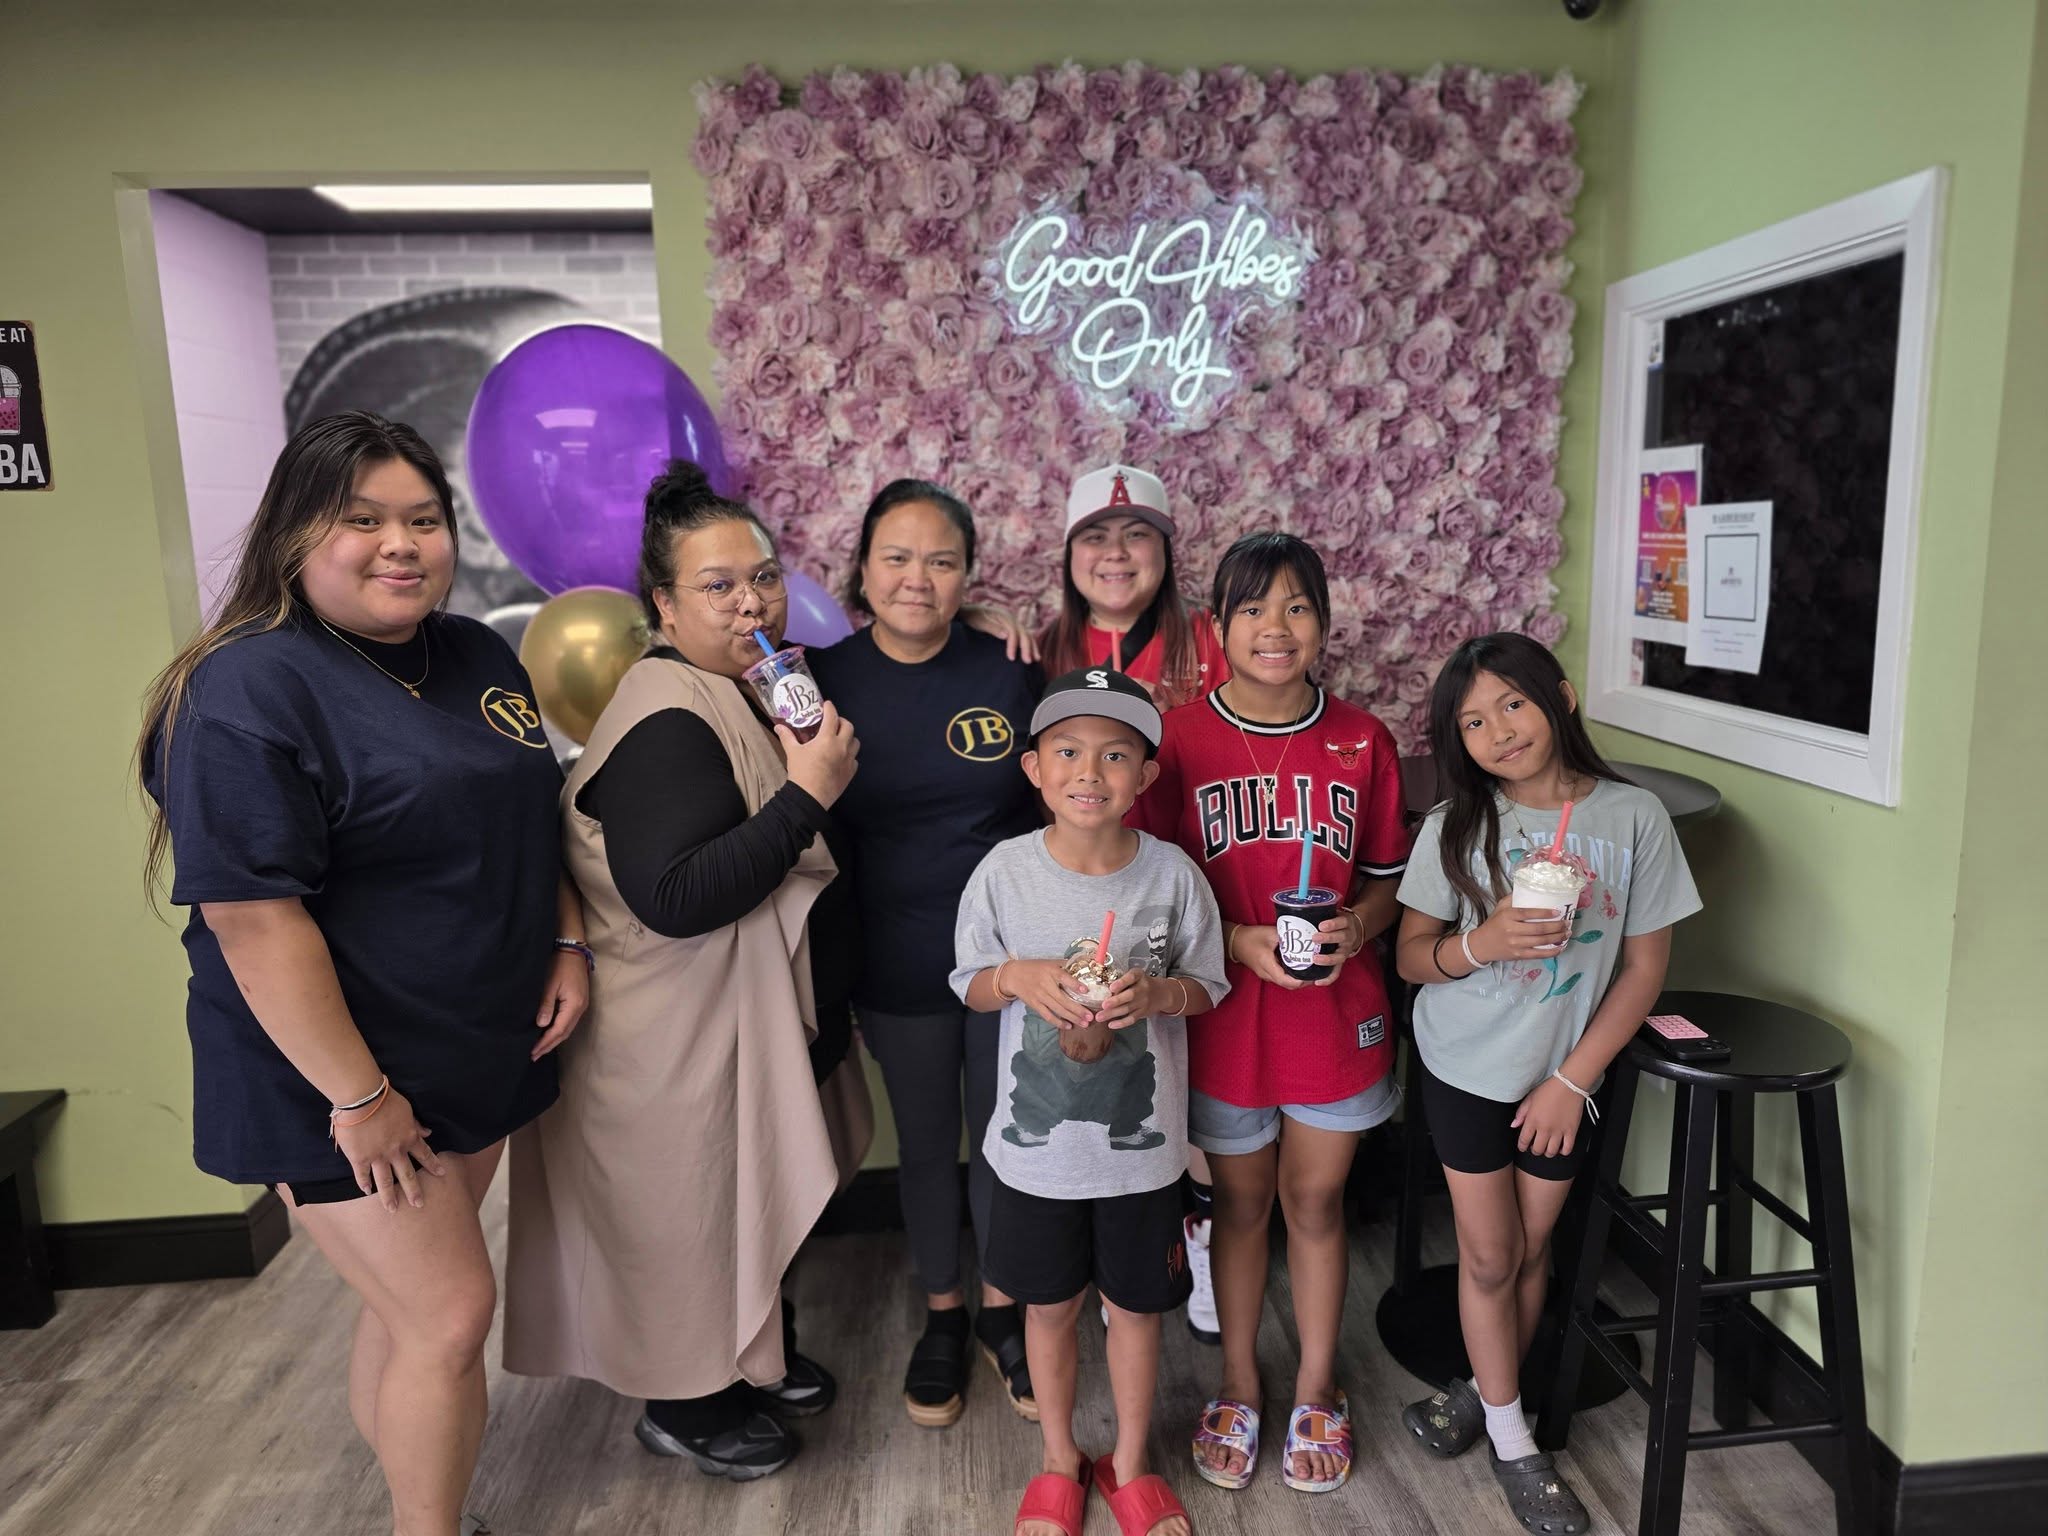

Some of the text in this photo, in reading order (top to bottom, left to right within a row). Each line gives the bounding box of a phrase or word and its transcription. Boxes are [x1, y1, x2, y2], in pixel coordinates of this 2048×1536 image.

[1005, 204, 1302, 325] Good Vibes
[10, 327, 27, 343] AT
[1071, 297, 1233, 408] Only
[486, 697, 540, 739] JB
[955, 715, 1009, 754] JB
[1195, 775, 1358, 864] BULLS
